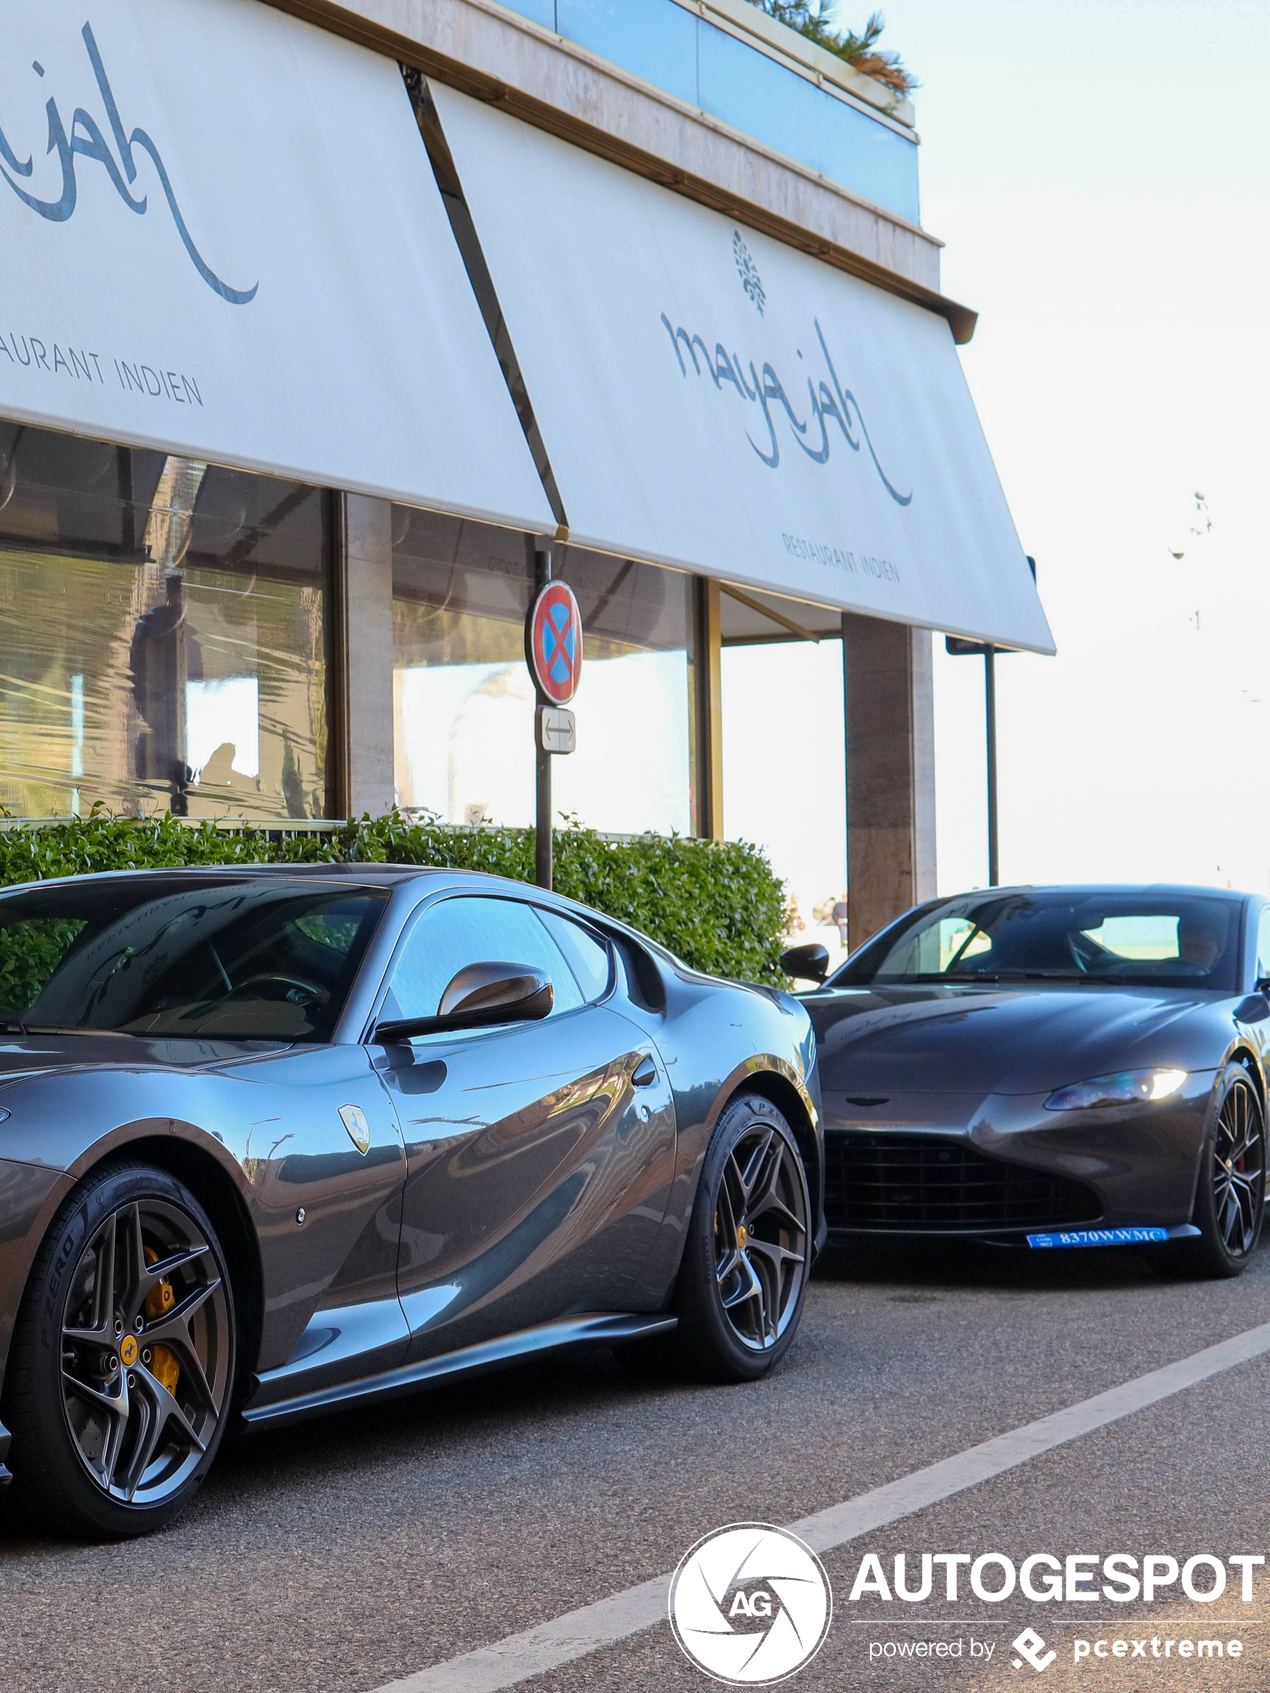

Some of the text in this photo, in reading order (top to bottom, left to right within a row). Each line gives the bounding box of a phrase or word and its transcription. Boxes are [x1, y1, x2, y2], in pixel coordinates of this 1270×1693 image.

[114, 358, 204, 407] INDIEN
[782, 532, 902, 583] RESTAURANT INDIEN
[44, 1233, 74, 1322] ZERO
